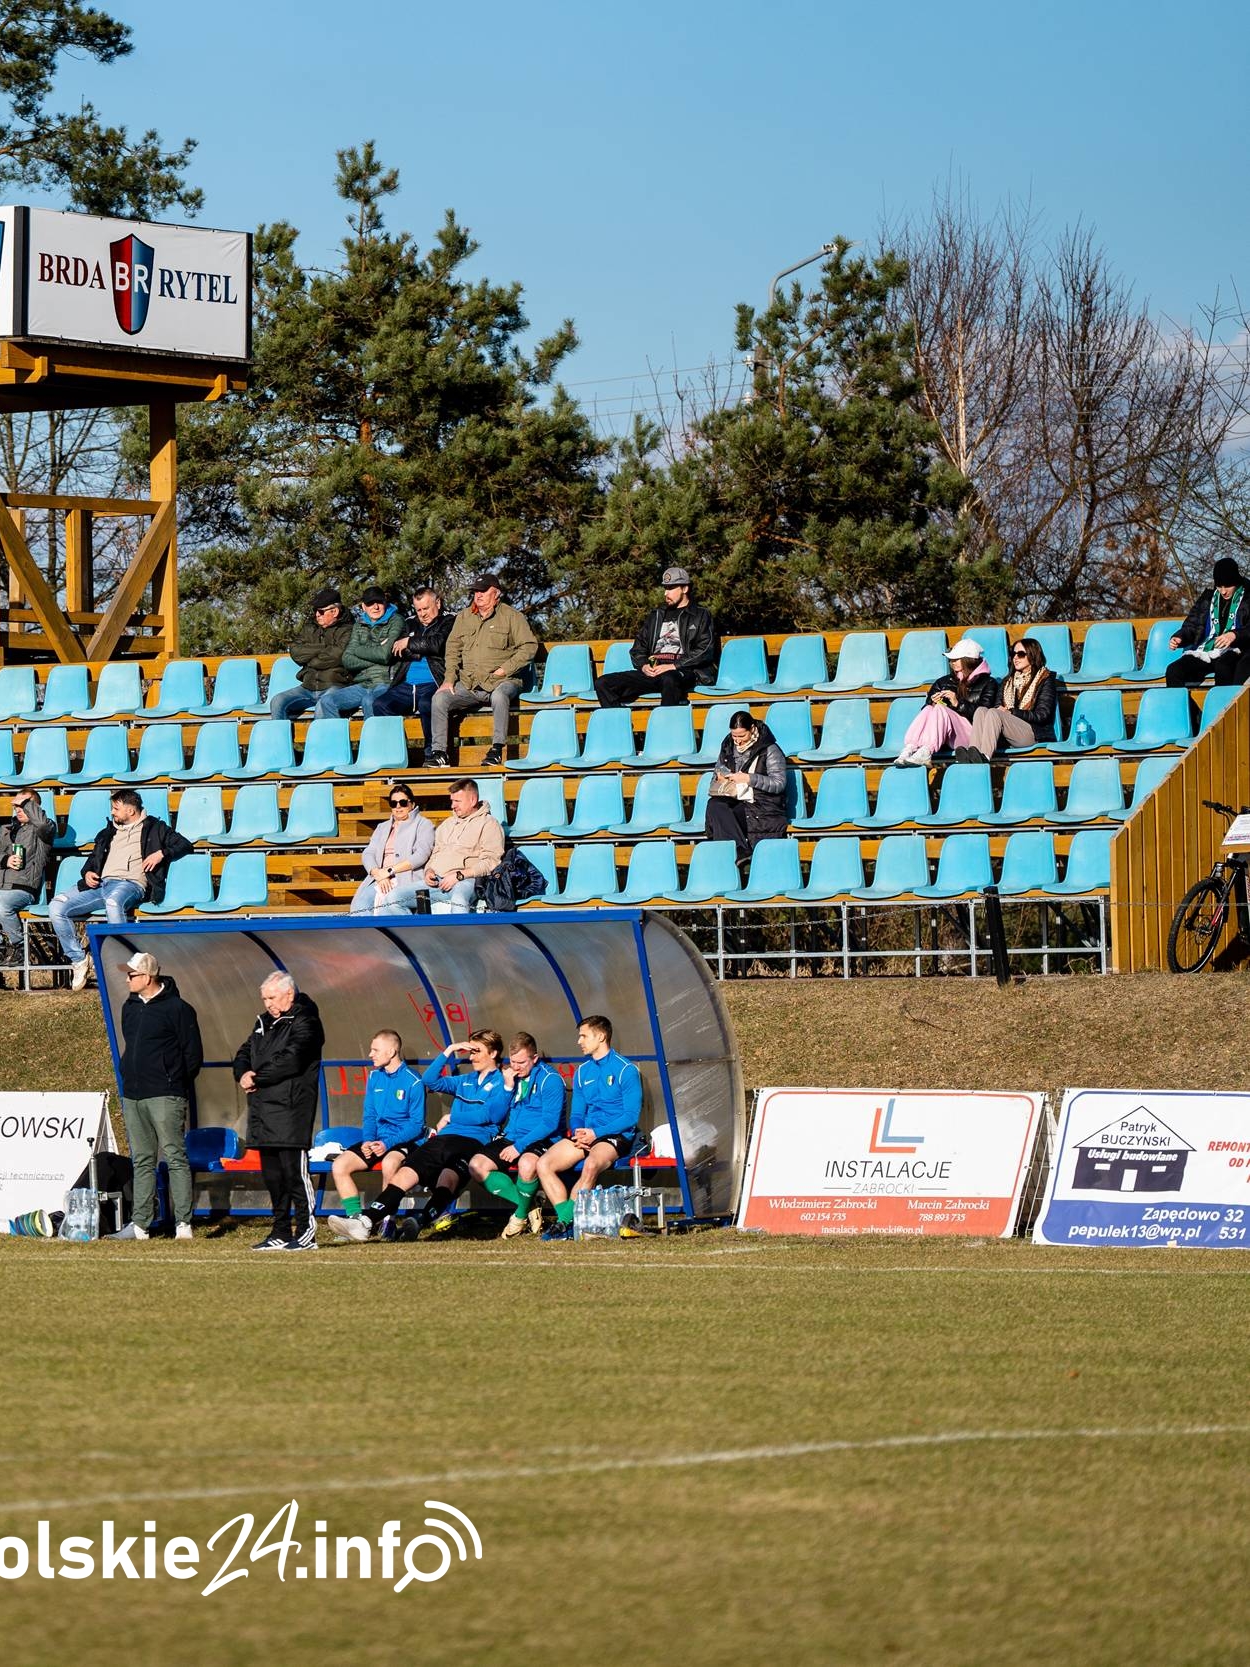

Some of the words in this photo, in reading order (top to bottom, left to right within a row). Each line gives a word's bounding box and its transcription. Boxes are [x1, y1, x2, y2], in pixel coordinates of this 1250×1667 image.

[38, 251, 107, 290] BRDA
[113, 261, 150, 295] BR
[158, 268, 238, 305] RYTEL
[1120, 1121, 1157, 1133] Patryk
[1122, 1149, 1178, 1162] budowlane
[1228, 1157, 1245, 1168] OD
[825, 1160, 953, 1179] INSTALACJE
[852, 1182, 915, 1195] ZABROCKI
[769, 1199, 831, 1210] Włodzimierz
[833, 1199, 878, 1209] Zabrocki
[907, 1200, 943, 1210] Marcin
[944, 1200, 990, 1210] Zabrocki
[800, 1213, 817, 1222] 602
[831, 1213, 847, 1222] 735
[918, 1213, 935, 1222] 788
[949, 1213, 966, 1222] 735
[1142, 1207, 1221, 1223] Zapędowo
[1223, 1208, 1245, 1223] 32
[1068, 1224, 1201, 1239] pepulek13@wp.pl
[1218, 1226, 1247, 1240] 531
